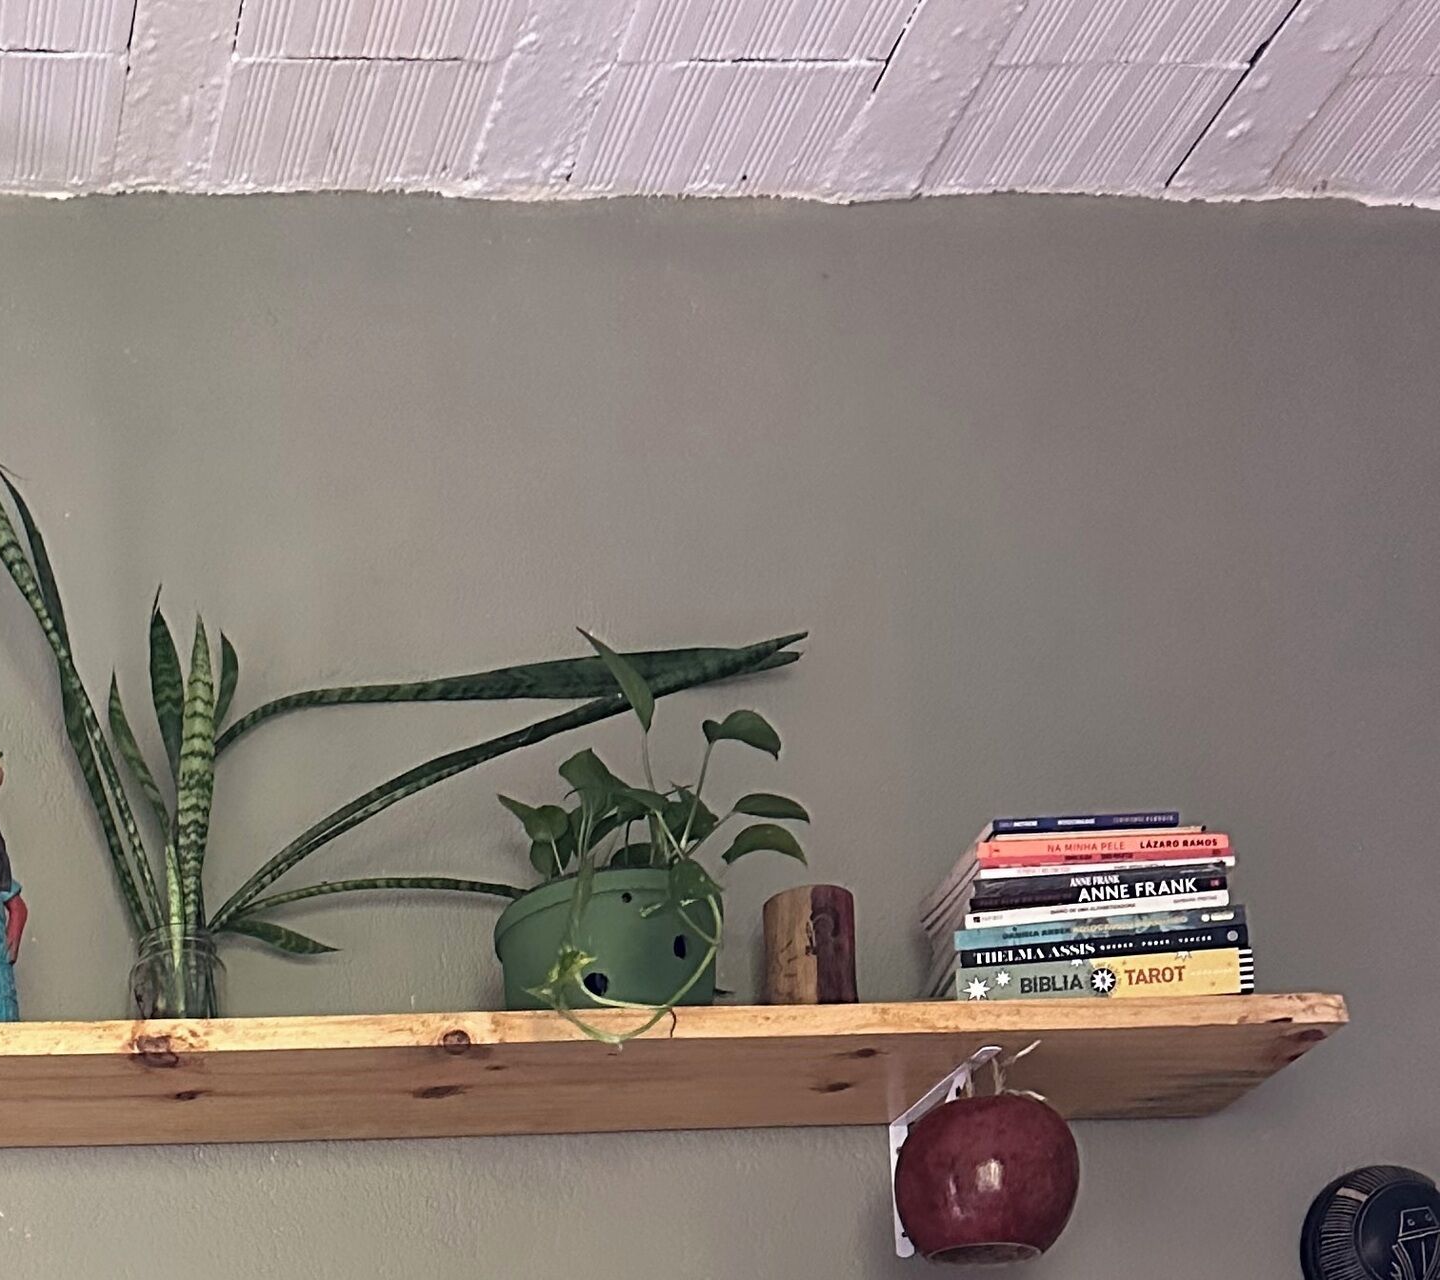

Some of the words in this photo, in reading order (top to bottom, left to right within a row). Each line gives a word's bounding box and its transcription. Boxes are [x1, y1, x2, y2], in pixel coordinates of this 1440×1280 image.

[1047, 843, 1062, 852] NA
[1064, 842, 1098, 852] MINHA
[1101, 840, 1125, 851] PELE
[1182, 838, 1218, 848] RAMOS
[1069, 876, 1092, 888] ANNE
[1092, 874, 1121, 886] FRANK
[1078, 883, 1130, 903] ANNE
[1134, 877, 1198, 898] FRANK
[973, 947, 1046, 965] THELMA
[1048, 942, 1096, 959] ASSIS
[1124, 965, 1186, 986] TAROT
